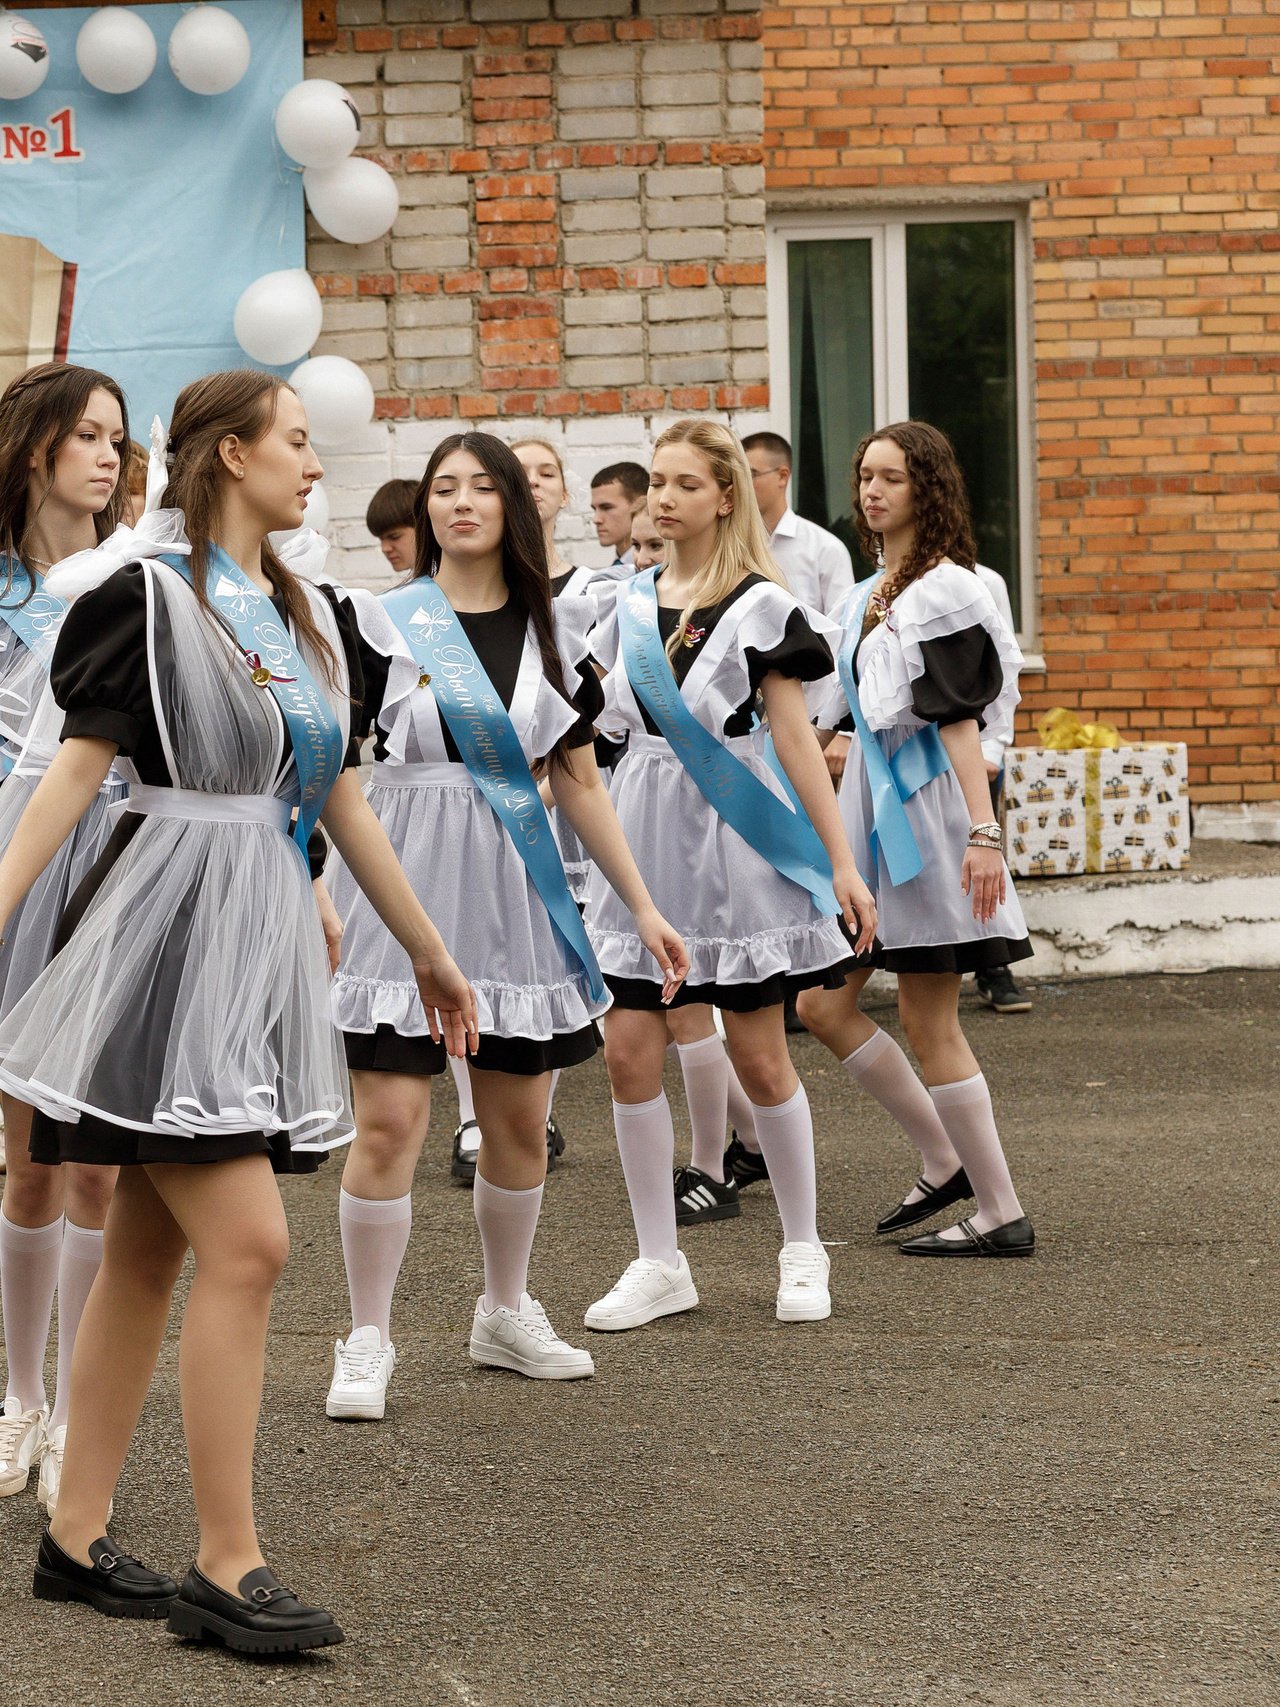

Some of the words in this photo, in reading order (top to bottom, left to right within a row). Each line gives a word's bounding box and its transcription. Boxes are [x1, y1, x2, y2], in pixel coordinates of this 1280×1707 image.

[2, 109, 81, 160] №1
[431, 644, 511, 792] Выпускница
[502, 788, 541, 846] 2026
[631, 616, 693, 748] Выпускница
